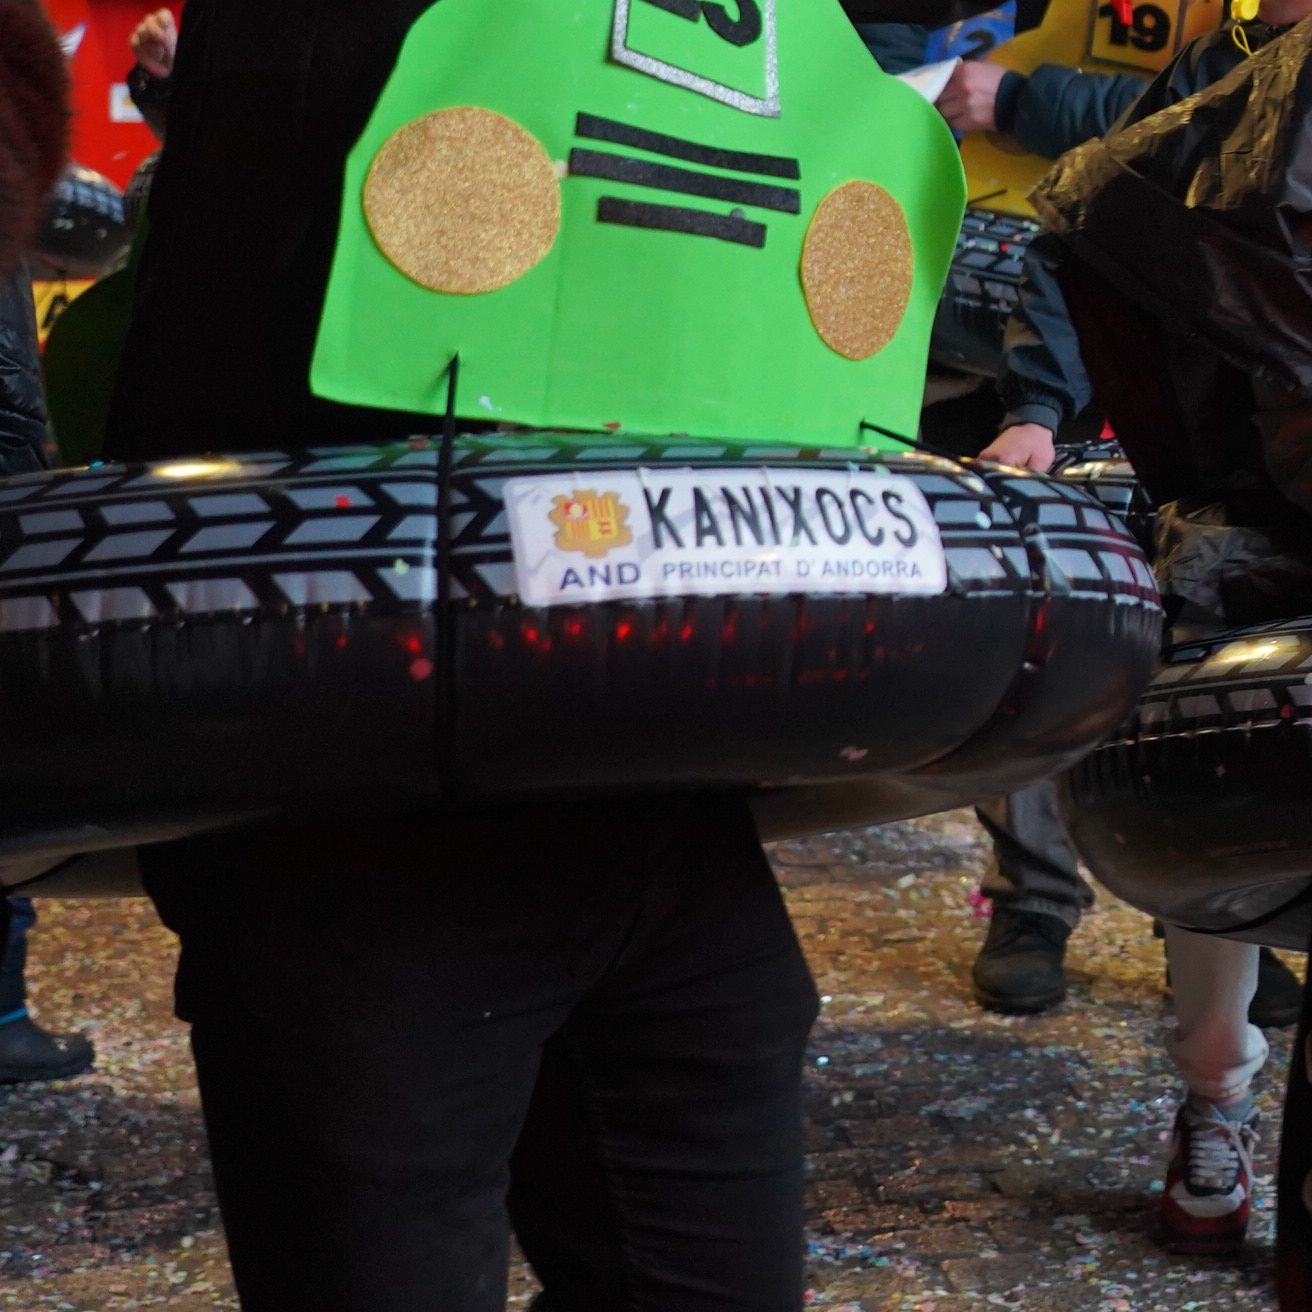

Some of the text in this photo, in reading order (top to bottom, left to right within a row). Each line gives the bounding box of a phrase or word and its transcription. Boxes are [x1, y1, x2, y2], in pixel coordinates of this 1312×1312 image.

[1099, 1, 1171, 53] 19
[641, 483, 918, 550] KANIXOCS
[559, 561, 641, 590] AND
[662, 558, 782, 579] PRINCIPAT
